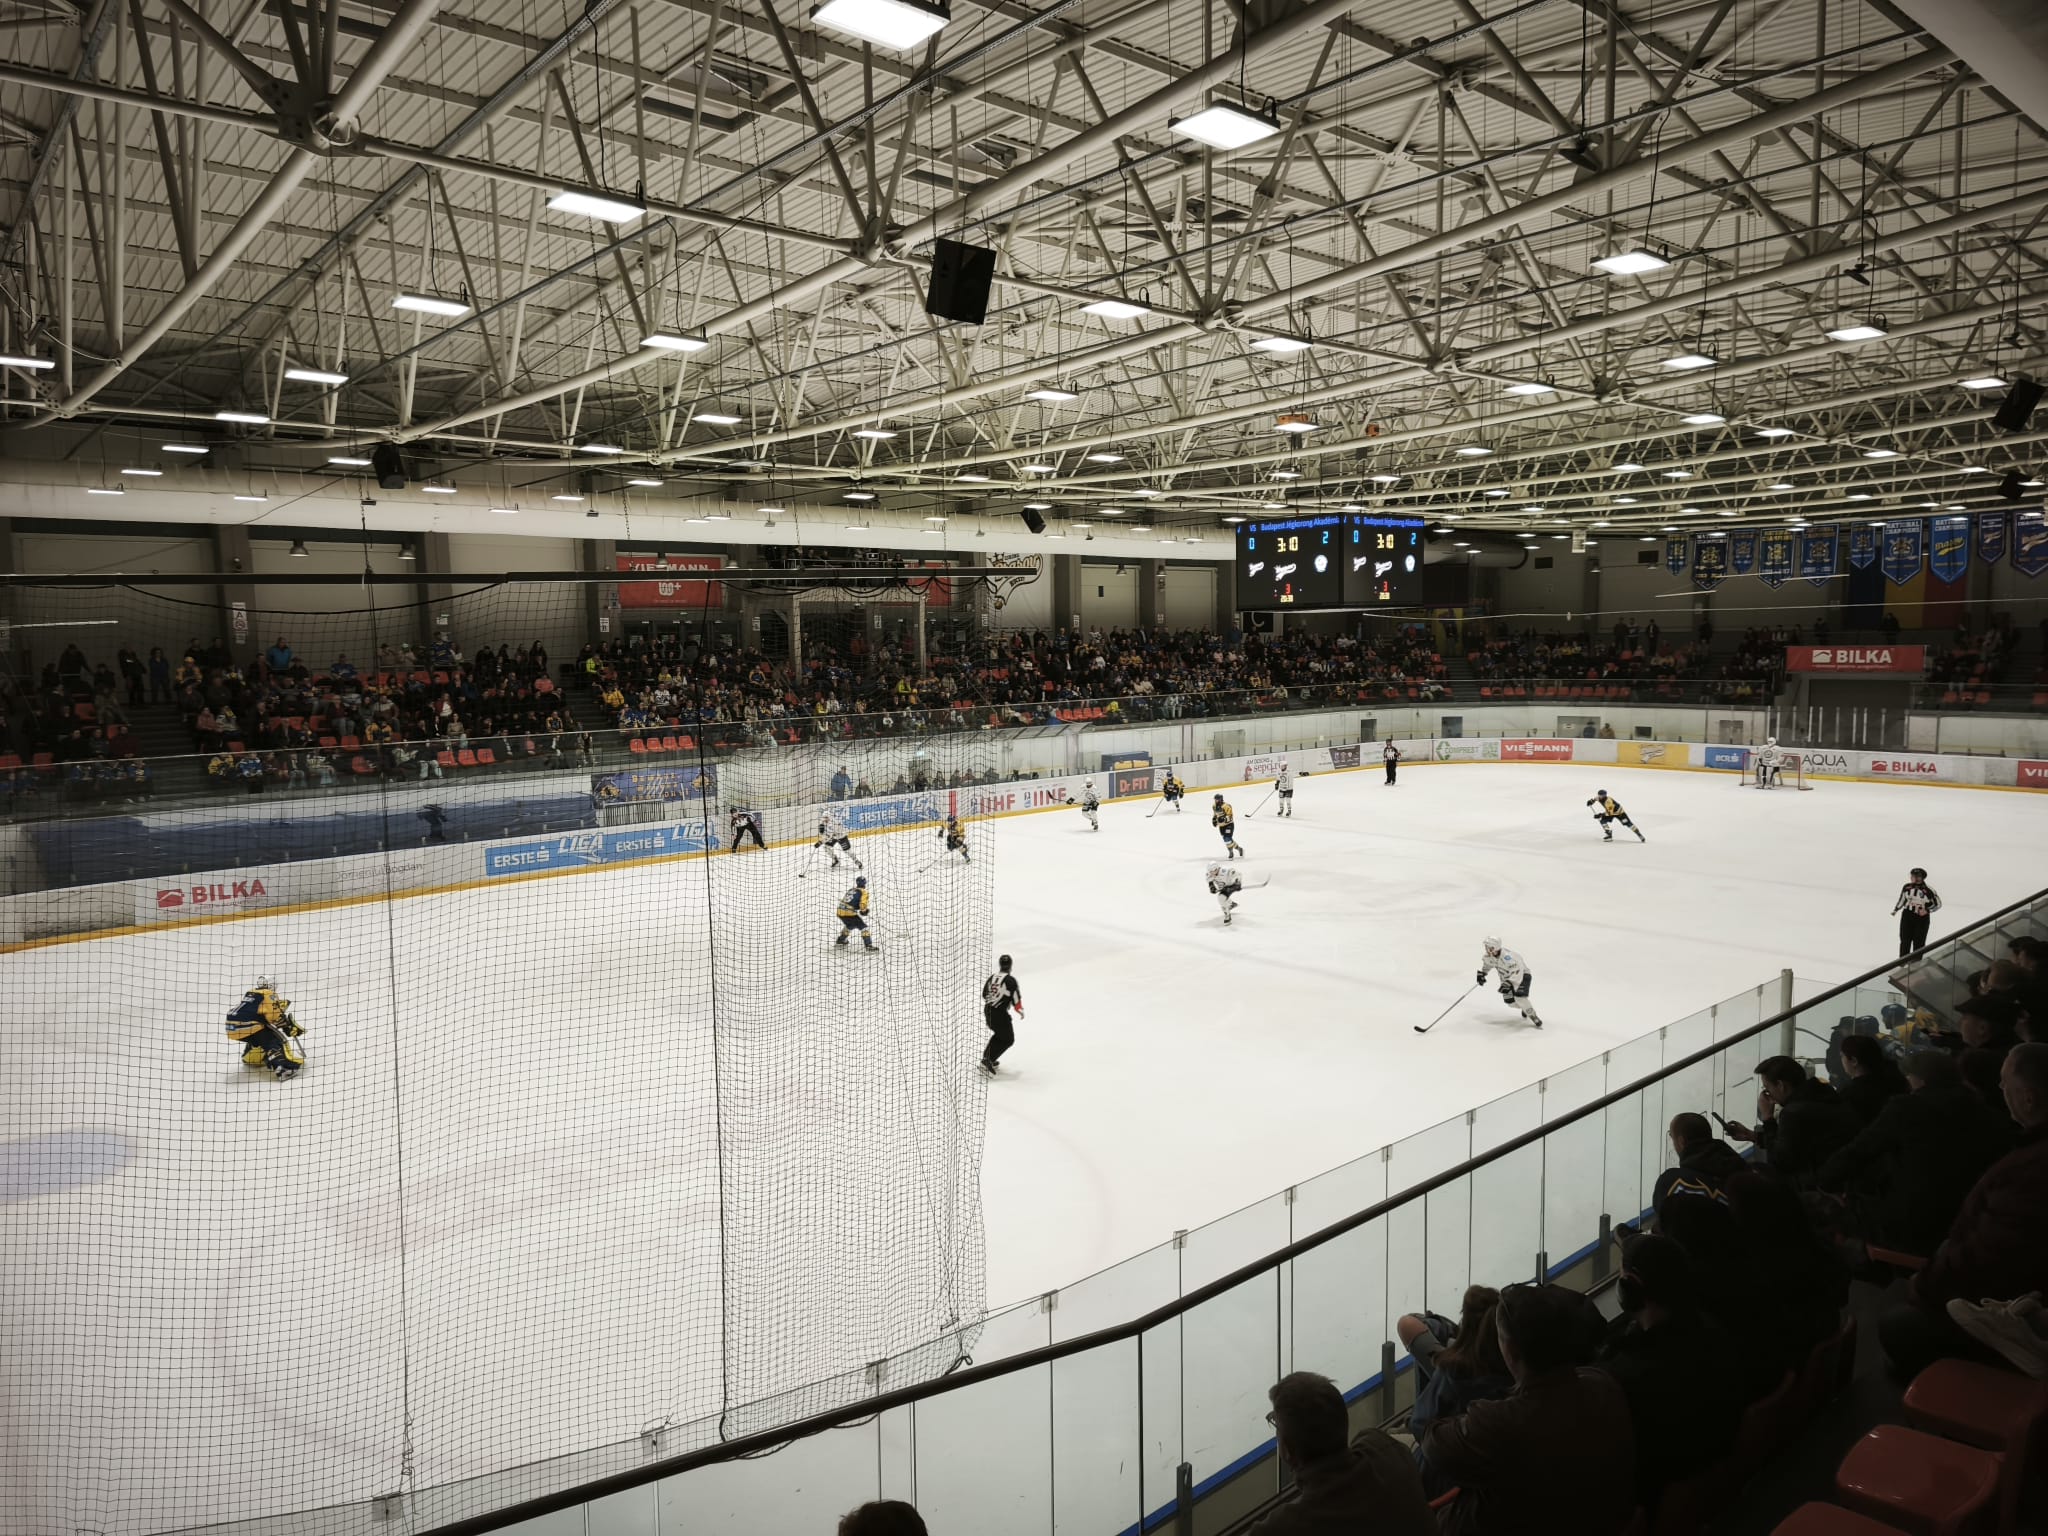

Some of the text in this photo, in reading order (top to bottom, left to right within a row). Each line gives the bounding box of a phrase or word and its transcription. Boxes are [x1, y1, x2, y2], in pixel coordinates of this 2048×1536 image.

[1249, 531, 1329, 553] 0 3:10 2
[1353, 530, 1359, 543] 0
[1411, 533, 1416, 545] 2
[1285, 584, 1291, 594] 3
[1836, 650, 1892, 663] BILKA
[1505, 742, 1570, 756] VIESSMANN
[1802, 754, 1848, 767] AQUA
[1891, 761, 1937, 773] BILKA
[1120, 780, 1131, 793] Dr
[1132, 777, 1150, 791] FIT
[980, 794, 1015, 814] IIHF
[495, 821, 714, 868] ERSTE LIGA ERSTE LIGA
[385, 862, 423, 875] Bogdan
[191, 879, 267, 904] BILKA
